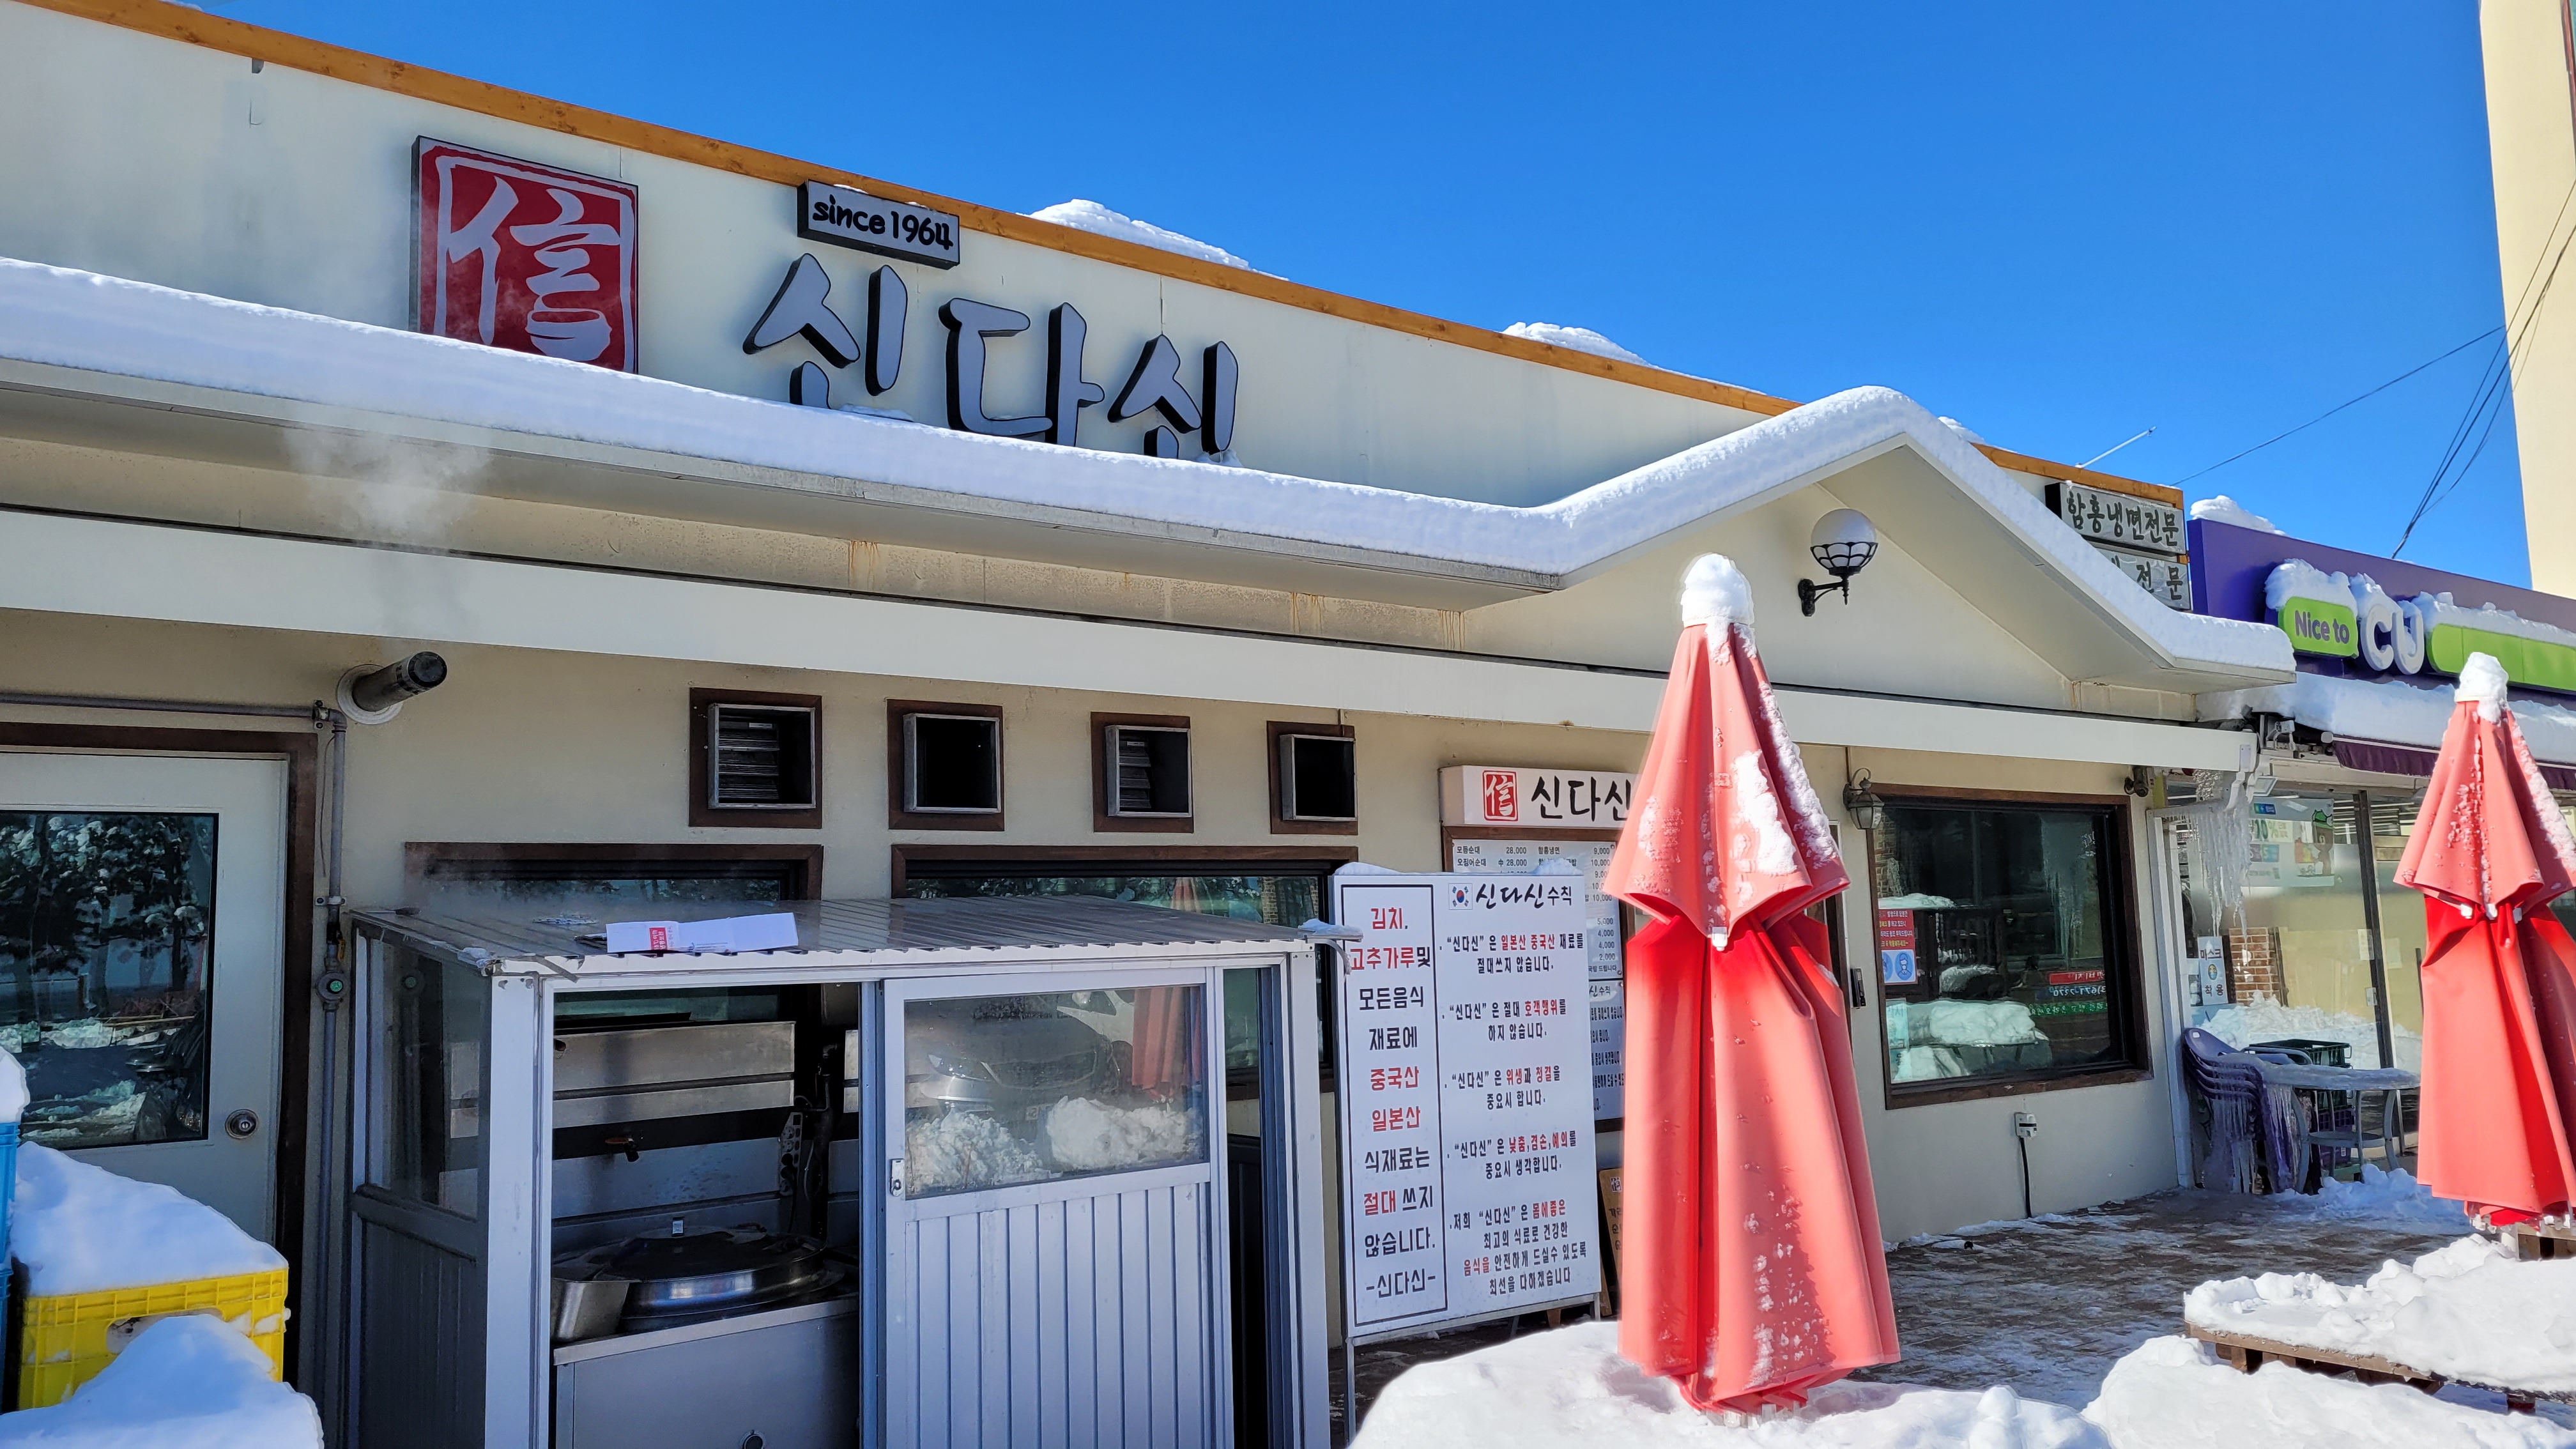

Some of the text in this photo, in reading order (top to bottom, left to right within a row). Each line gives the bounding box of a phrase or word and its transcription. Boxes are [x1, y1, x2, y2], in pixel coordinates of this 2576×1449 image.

[813, 194, 954, 250] since 1964
[448, 176, 620, 361] 信
[743, 253, 1238, 459] 신다신
[2066, 491, 2179, 546] 함흥냉면전문
[2294, 610, 2350, 645] Nice to
[2363, 604, 2425, 675] CU
[1486, 775, 1514, 816] 信
[1531, 775, 1631, 822] 신다신
[1370, 907, 1408, 930] 김치,
[1489, 935, 1496, 951] 은
[1501, 934, 1526, 951] 일본산
[1531, 933, 1555, 950] 중국산
[1560, 933, 1583, 949] 재료를
[2200, 948, 2222, 961] 마스크
[1516, 956, 1554, 972] 않습니다.
[1359, 986, 1424, 1011] 모든음식
[1492, 1002, 1499, 1018] 은
[1503, 1001, 1520, 1018] 절대
[1524, 999, 1566, 1016] 호객행위를
[1369, 1026, 1418, 1050] 재료에
[1488, 1022, 1547, 1041] 하지 않습니다.
[1370, 1066, 1420, 1091] 중국산
[1494, 1070, 1502, 1086] 은
[1506, 1068, 1531, 1085] 위생과
[1487, 1089, 1545, 1110] 중요시 합니다.
[1372, 1107, 1421, 1131] 일본산
[1497, 1138, 1505, 1154] 은
[1364, 1147, 1430, 1173] 식재료는
[1485, 1154, 1562, 1179] 중요시 생각합니다.
[1364, 1186, 1433, 1216] 절대 쓰지
[1521, 1204, 1528, 1221] 은
[1364, 1227, 1435, 1257] 않습니다.
[1483, 1221, 1568, 1250] 최고의 식료로 건강한
[1464, 1257, 1490, 1276] 음식을
[1494, 1250, 1528, 1272] 안전하게
[1562, 1241, 1586, 1261] 있도록
[1490, 1266, 1570, 1296] 최선을 다하겠습니다
